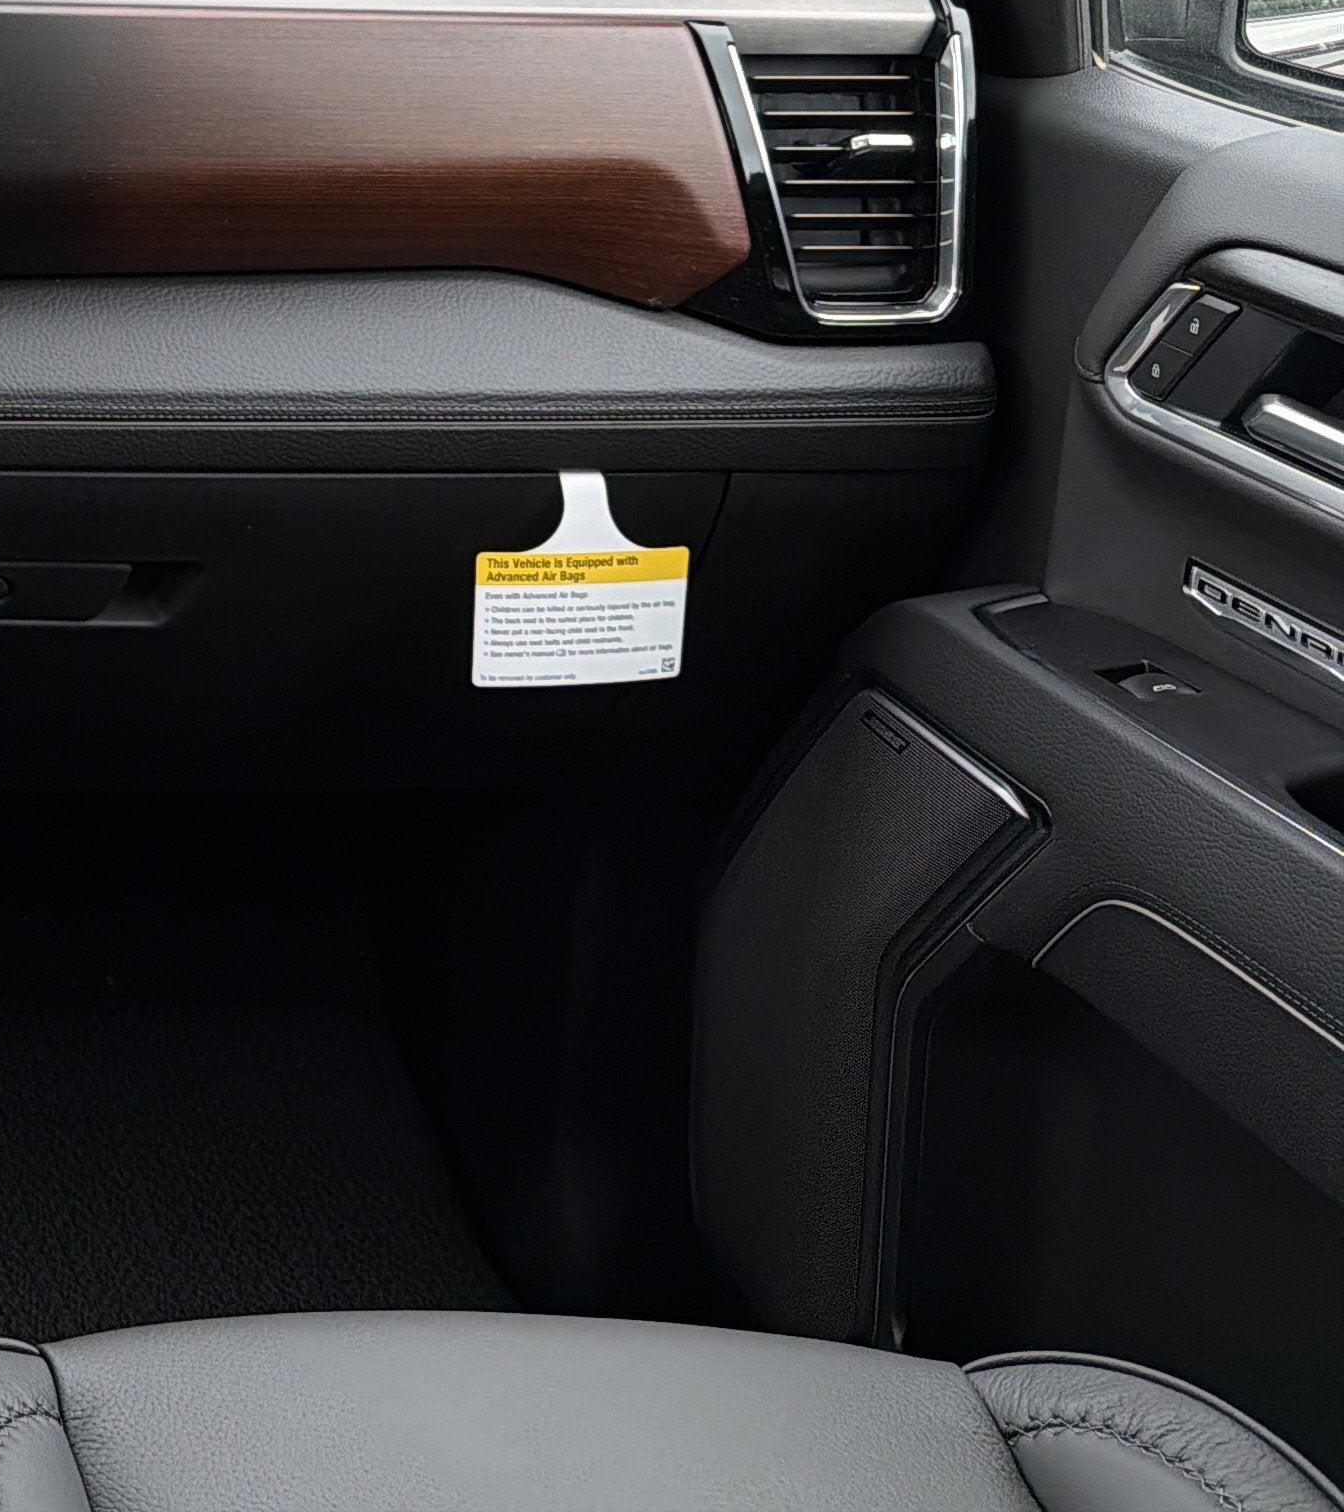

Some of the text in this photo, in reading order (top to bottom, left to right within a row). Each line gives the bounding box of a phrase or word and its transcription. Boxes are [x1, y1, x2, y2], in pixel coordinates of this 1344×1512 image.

[487, 558, 510, 569] This
[512, 558, 552, 569] Vehicle
[565, 556, 614, 571] Equipped
[616, 555, 639, 566] with
[486, 571, 586, 583] Advanced Air Bags
[1197, 576, 1344, 666] DENA
